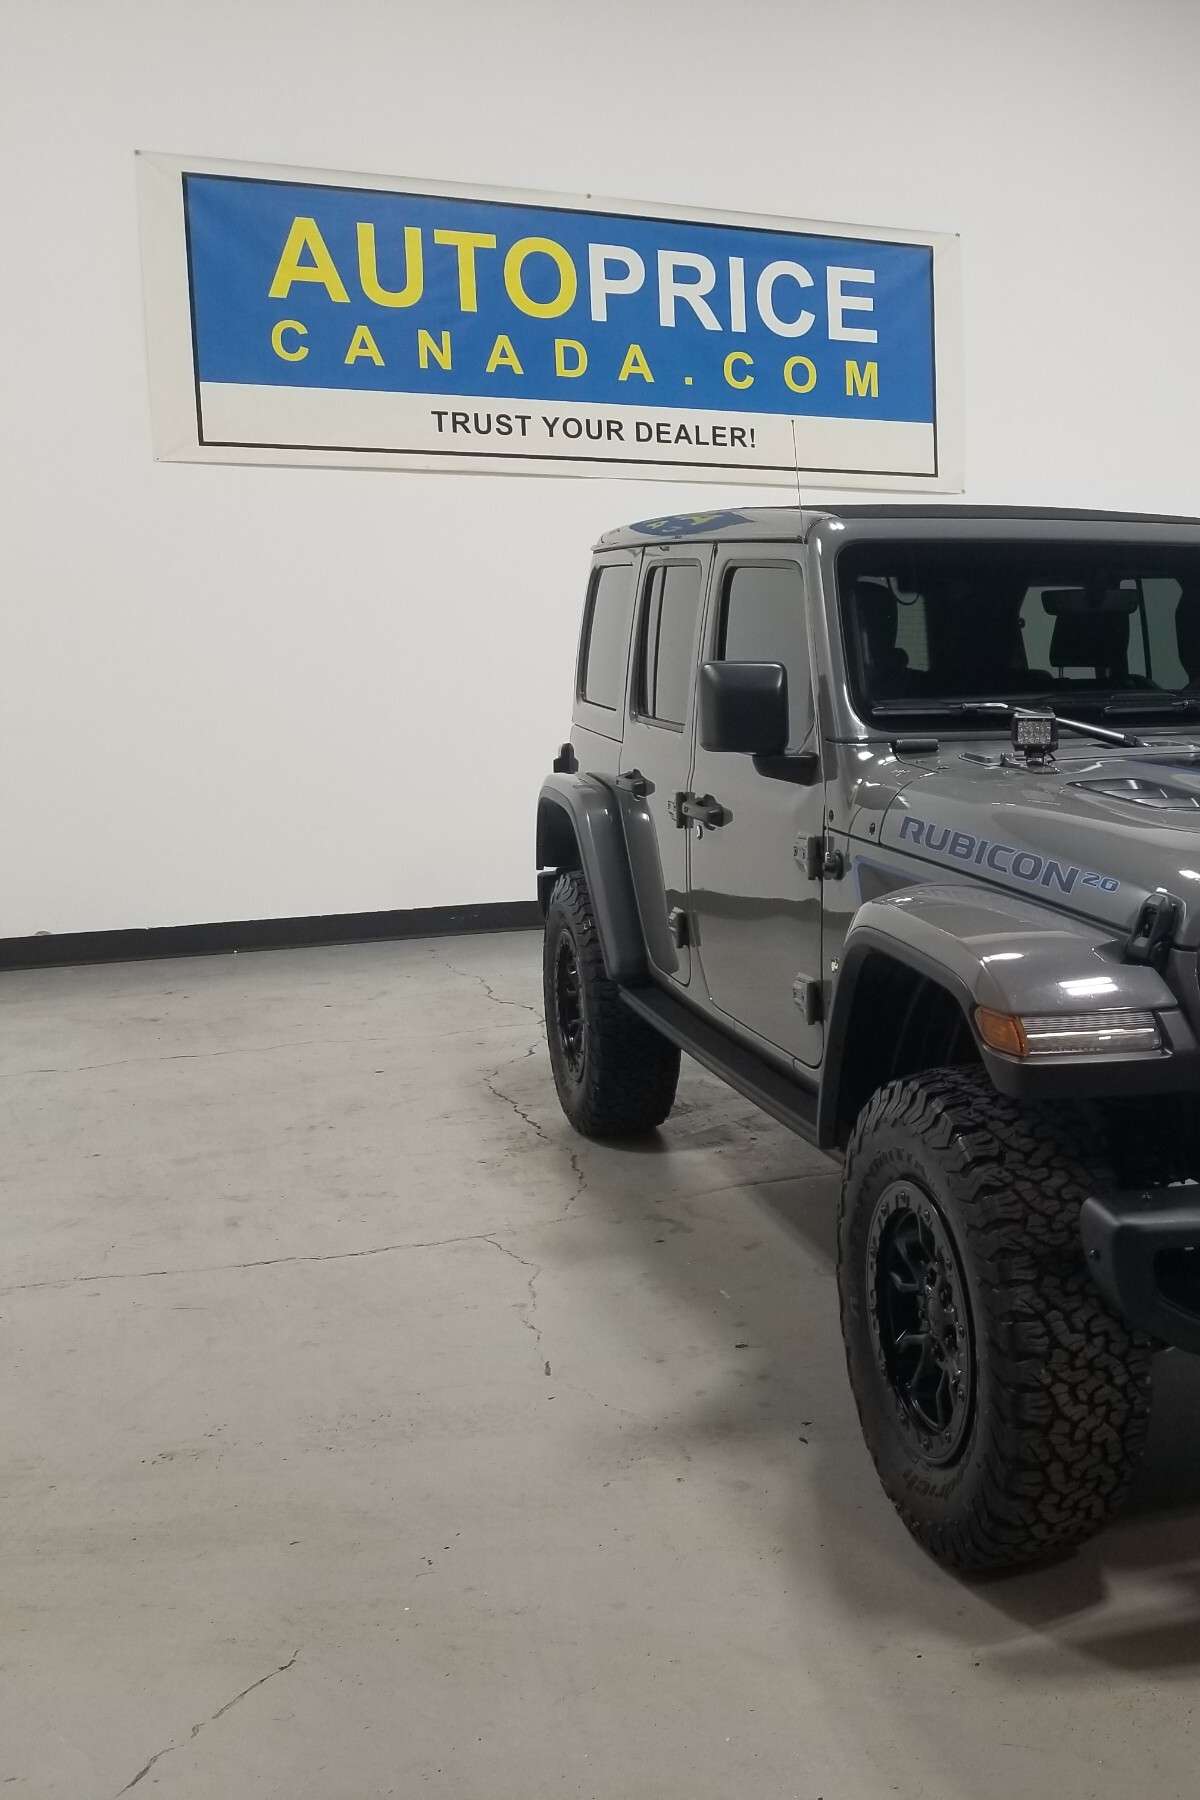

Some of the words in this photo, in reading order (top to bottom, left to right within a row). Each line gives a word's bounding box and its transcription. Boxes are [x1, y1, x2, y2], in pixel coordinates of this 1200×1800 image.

[268, 216, 879, 345] AUTOPRICE
[270, 319, 880, 398] CANADA.COM
[430, 410, 533, 437] TRUST
[541, 416, 626, 442] YOUR
[635, 421, 757, 449] DEALER!
[899, 815, 1080, 895] RUBICON
